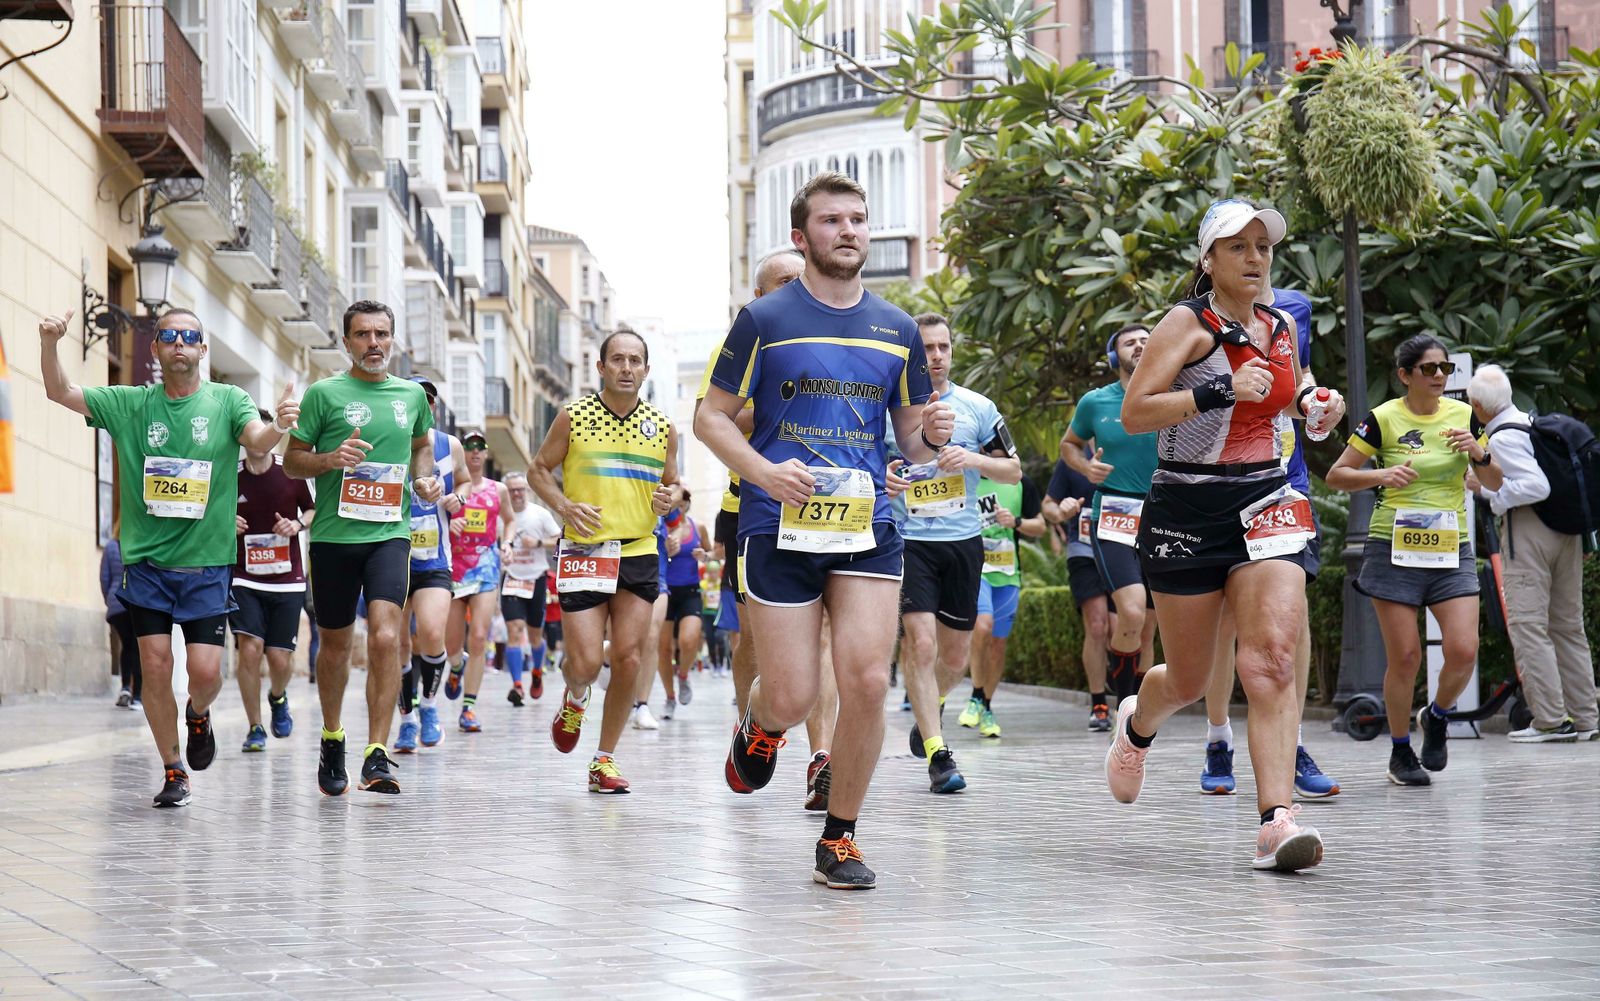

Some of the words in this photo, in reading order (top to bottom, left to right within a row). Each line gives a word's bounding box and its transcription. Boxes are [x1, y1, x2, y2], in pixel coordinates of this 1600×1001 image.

[153, 480, 188, 495] 7264
[347, 483, 384, 499] 5219
[914, 481, 948, 498] 6133
[798, 501, 850, 522] 7377
[1104, 515, 1136, 530] 3726
[1150, 526, 1164, 535] Club
[1164, 529, 1185, 539] Media
[1185, 533, 1202, 544] Trail
[1403, 532, 1440, 546] 6939
[250, 550, 275, 560] 3358
[563, 560, 597, 573] 3043
